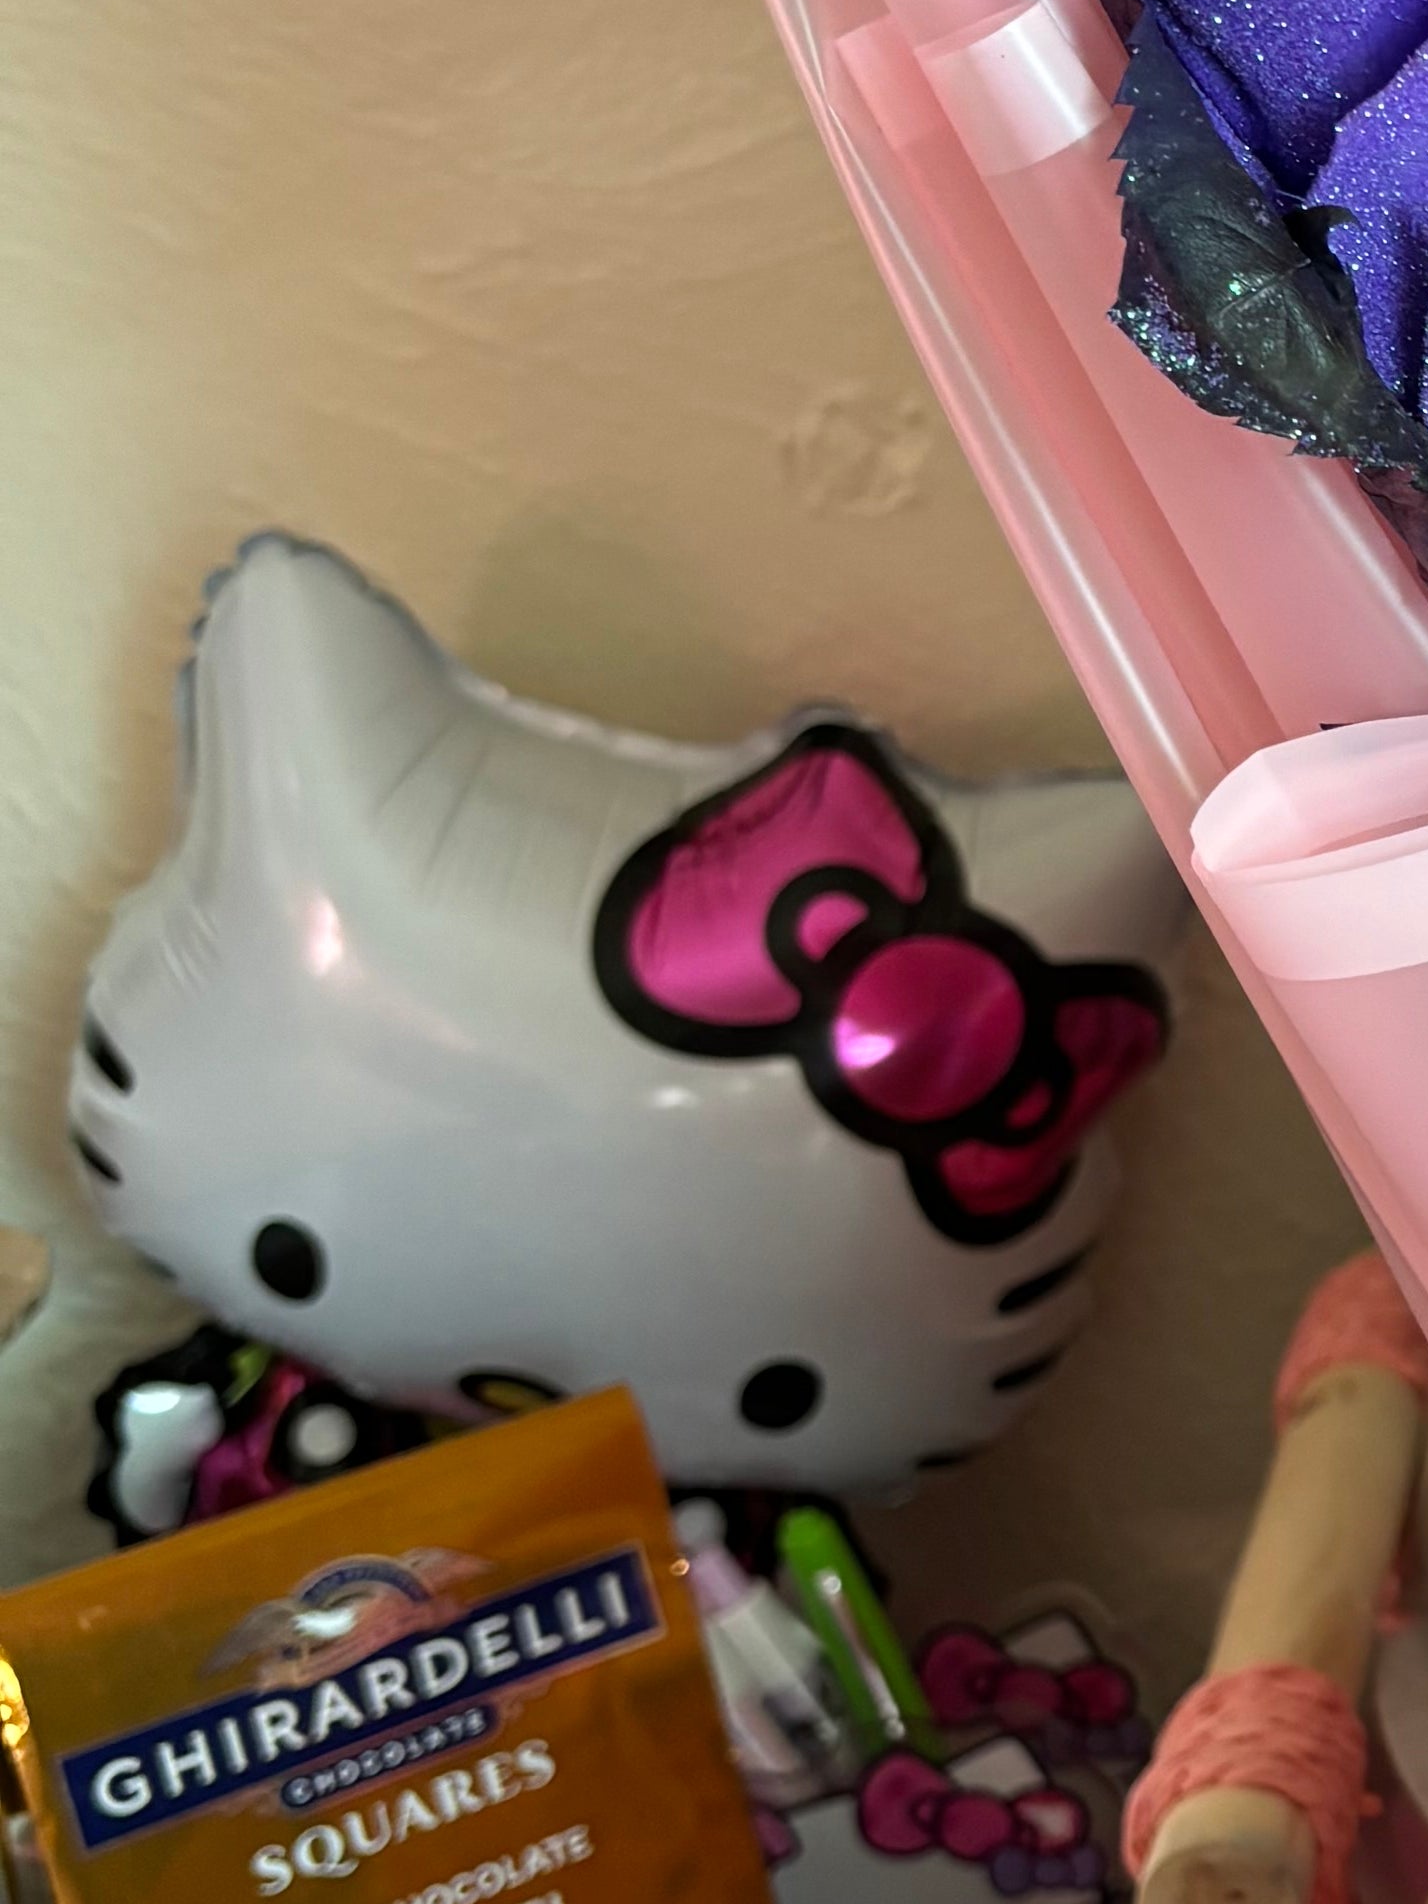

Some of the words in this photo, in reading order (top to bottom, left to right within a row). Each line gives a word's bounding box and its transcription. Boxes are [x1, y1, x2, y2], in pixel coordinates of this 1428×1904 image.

[90, 1568, 633, 1819] GHIRARDELLI
[285, 1706, 488, 1807] CHOCOLATE
[250, 1738, 557, 1896] SQUARES
